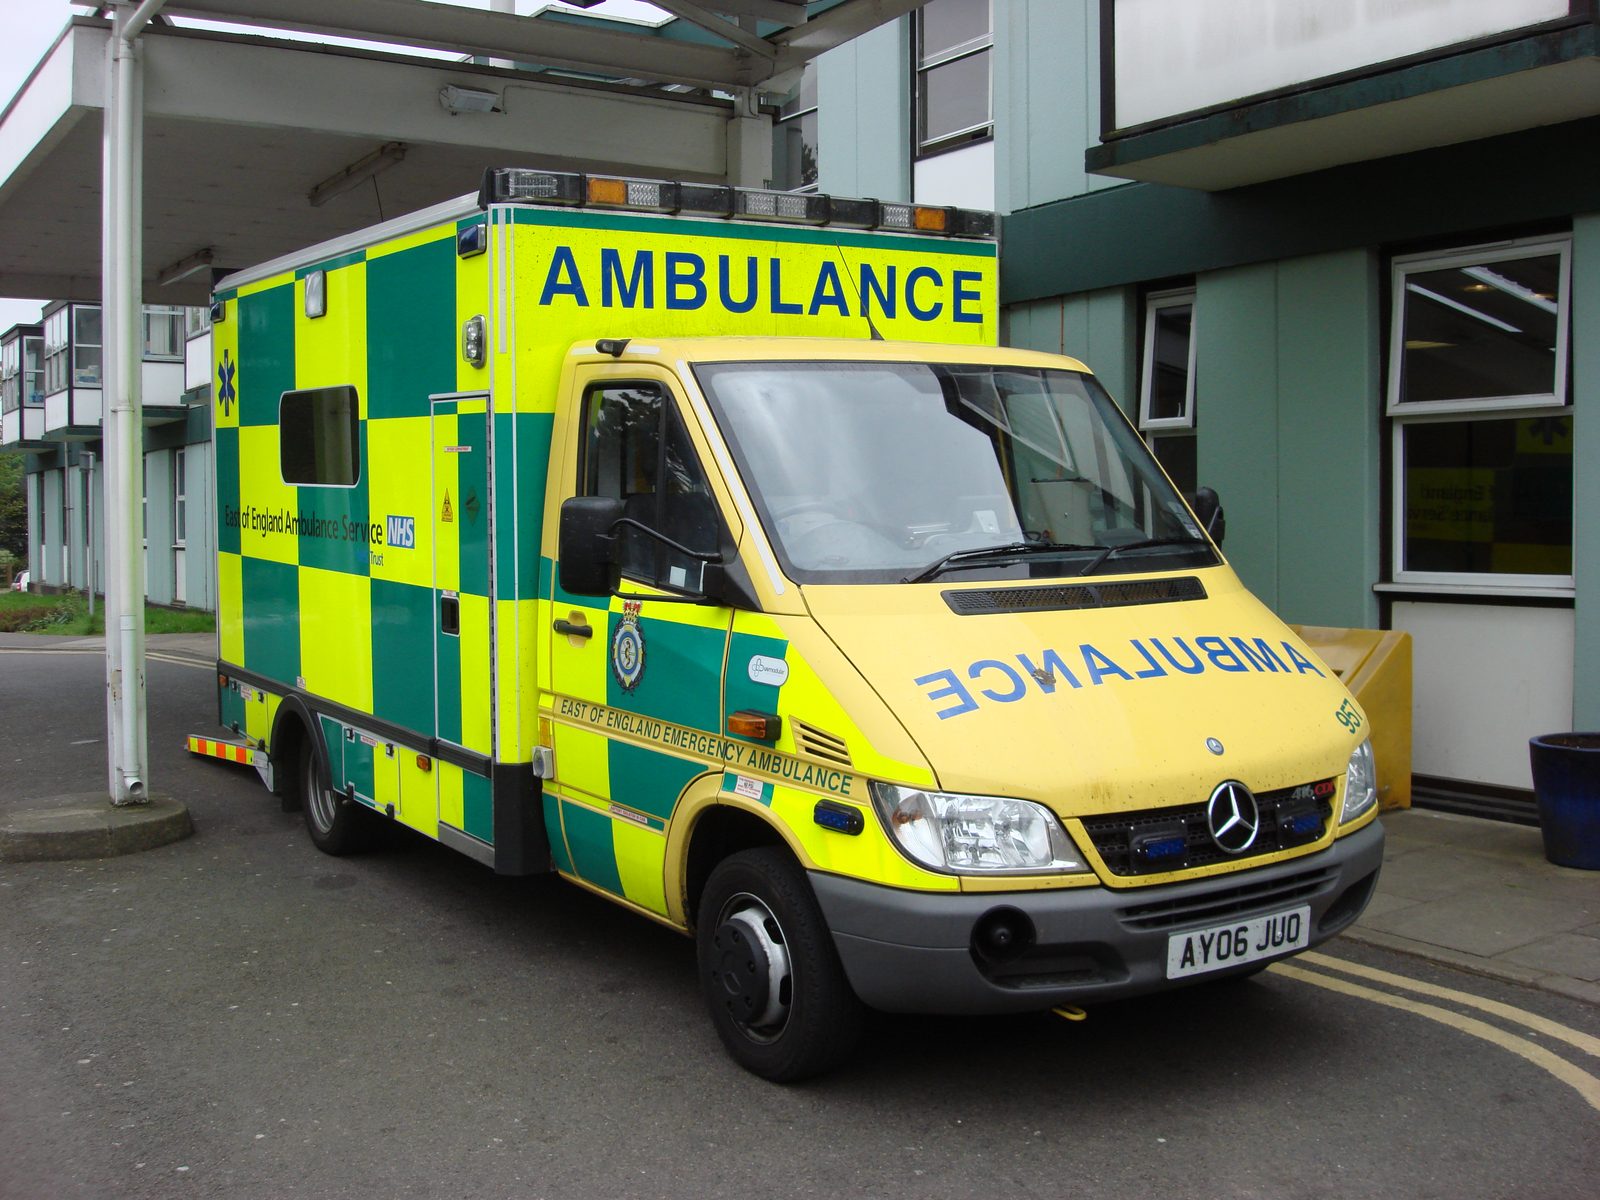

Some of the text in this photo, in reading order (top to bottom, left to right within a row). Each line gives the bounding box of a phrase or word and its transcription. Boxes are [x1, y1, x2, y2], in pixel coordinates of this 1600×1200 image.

[539, 245, 984, 324] AMBULANCE
[225, 505, 383, 545] East of England Ambulance Service
[387, 517, 414, 547] NHS
[369, 551, 384, 566] Trust
[1335, 698, 1363, 734] 957
[561, 700, 588, 719] EAST
[589, 708, 605, 724] OF
[606, 711, 661, 740] ENGLAND
[663, 726, 744, 764] EMERGENCY
[747, 749, 853, 795] AMBULANCE
[1180, 913, 1300, 969] AY06 JUO
